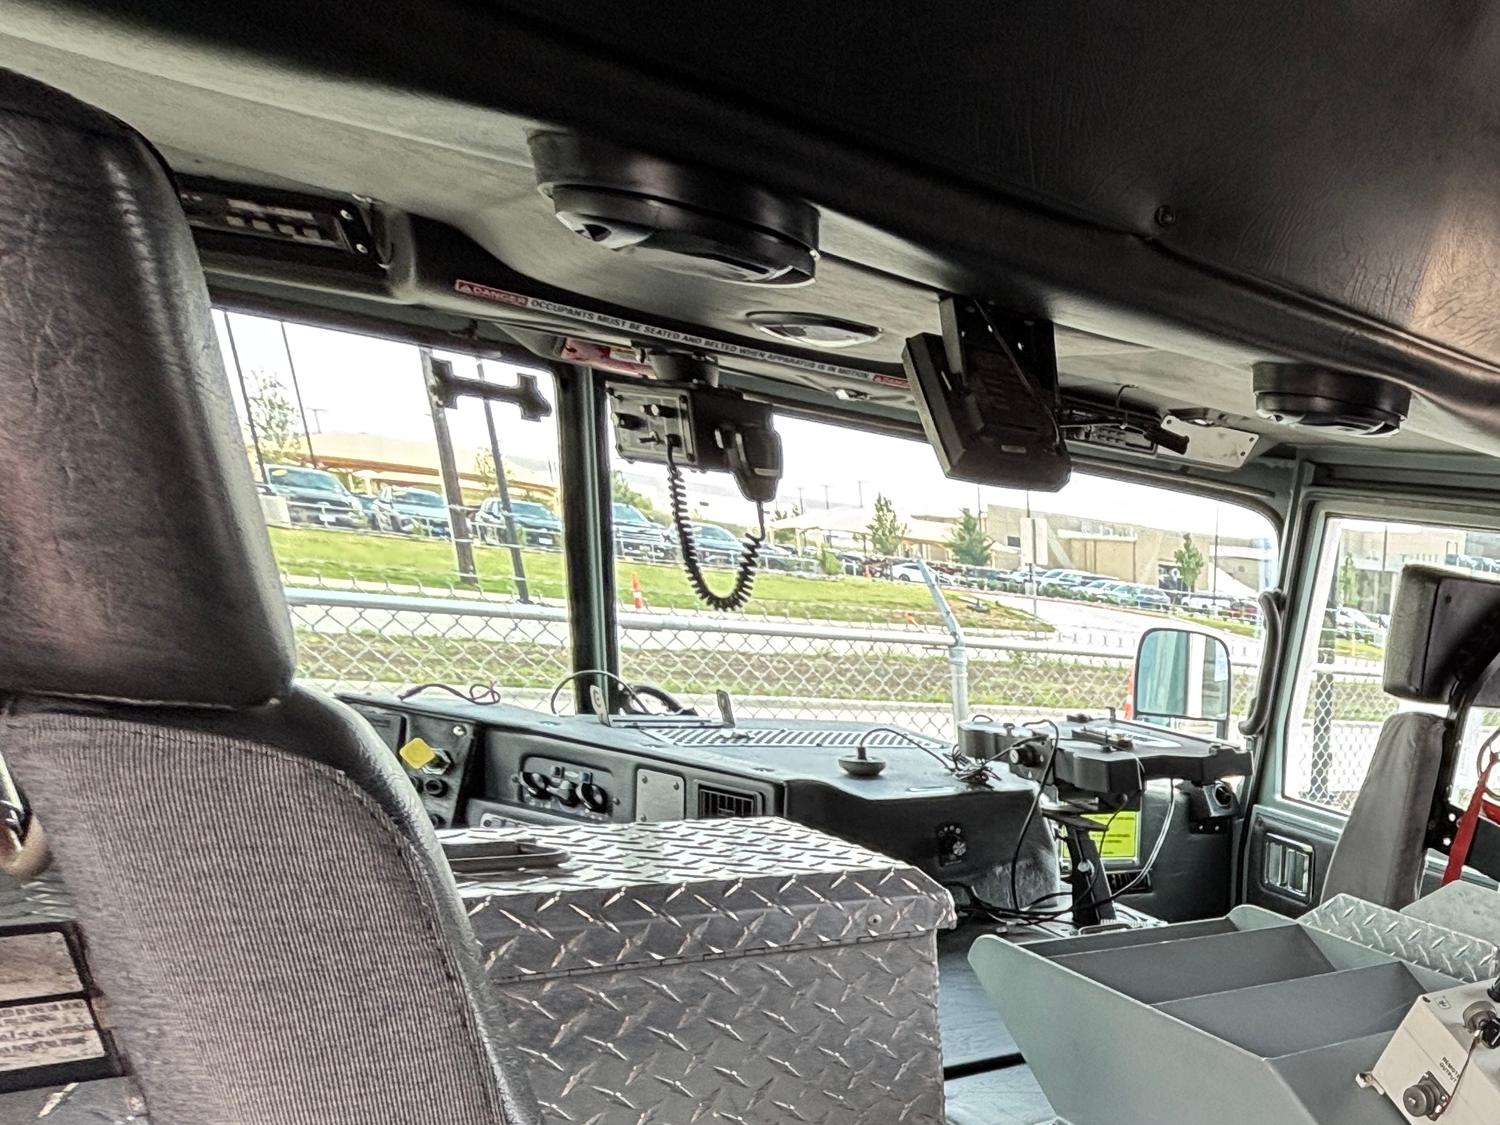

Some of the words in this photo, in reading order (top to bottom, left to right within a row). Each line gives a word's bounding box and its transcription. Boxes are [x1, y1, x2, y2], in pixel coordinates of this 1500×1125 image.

[473, 286, 527, 305] DANGER
[530, 299, 594, 321] OCCUPANTS
[597, 314, 627, 329] MUST
[629, 322, 642, 332] BE
[643, 326, 680, 341] SEATED
[682, 335, 702, 344] AND
[704, 339, 737, 353] BELTED
[739, 348, 766, 359] WHEN
[767, 353, 816, 369] APPARATUS
[838, 368, 869, 379] MOTION
